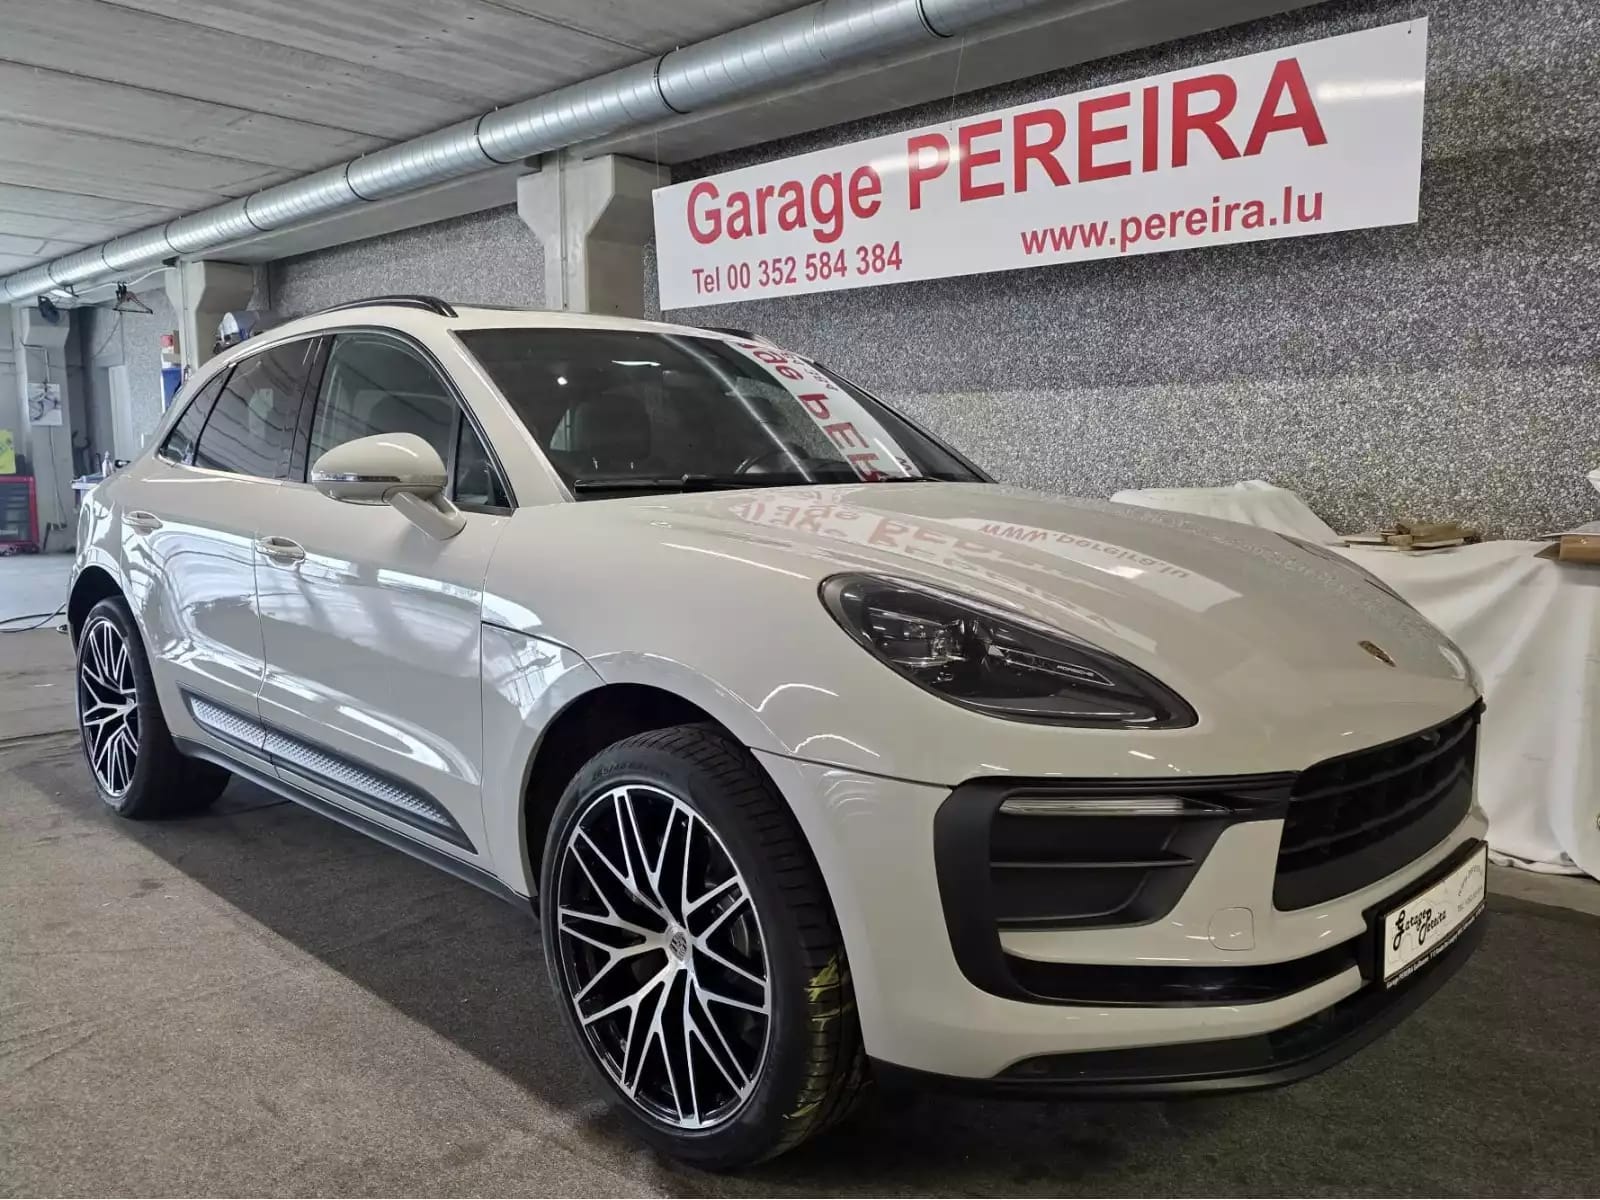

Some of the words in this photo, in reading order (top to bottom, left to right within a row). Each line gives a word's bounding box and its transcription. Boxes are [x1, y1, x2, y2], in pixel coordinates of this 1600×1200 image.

[687, 164, 882, 245] Garage
[907, 57, 1328, 211] PEREIRA
[1021, 186, 1324, 256] www.pereira.lu
[692, 267, 721, 294] Tel
[727, 262, 752, 292] 00
[757, 256, 798, 288] 352
[804, 249, 848, 282] 584
[856, 242, 903, 276] 384
